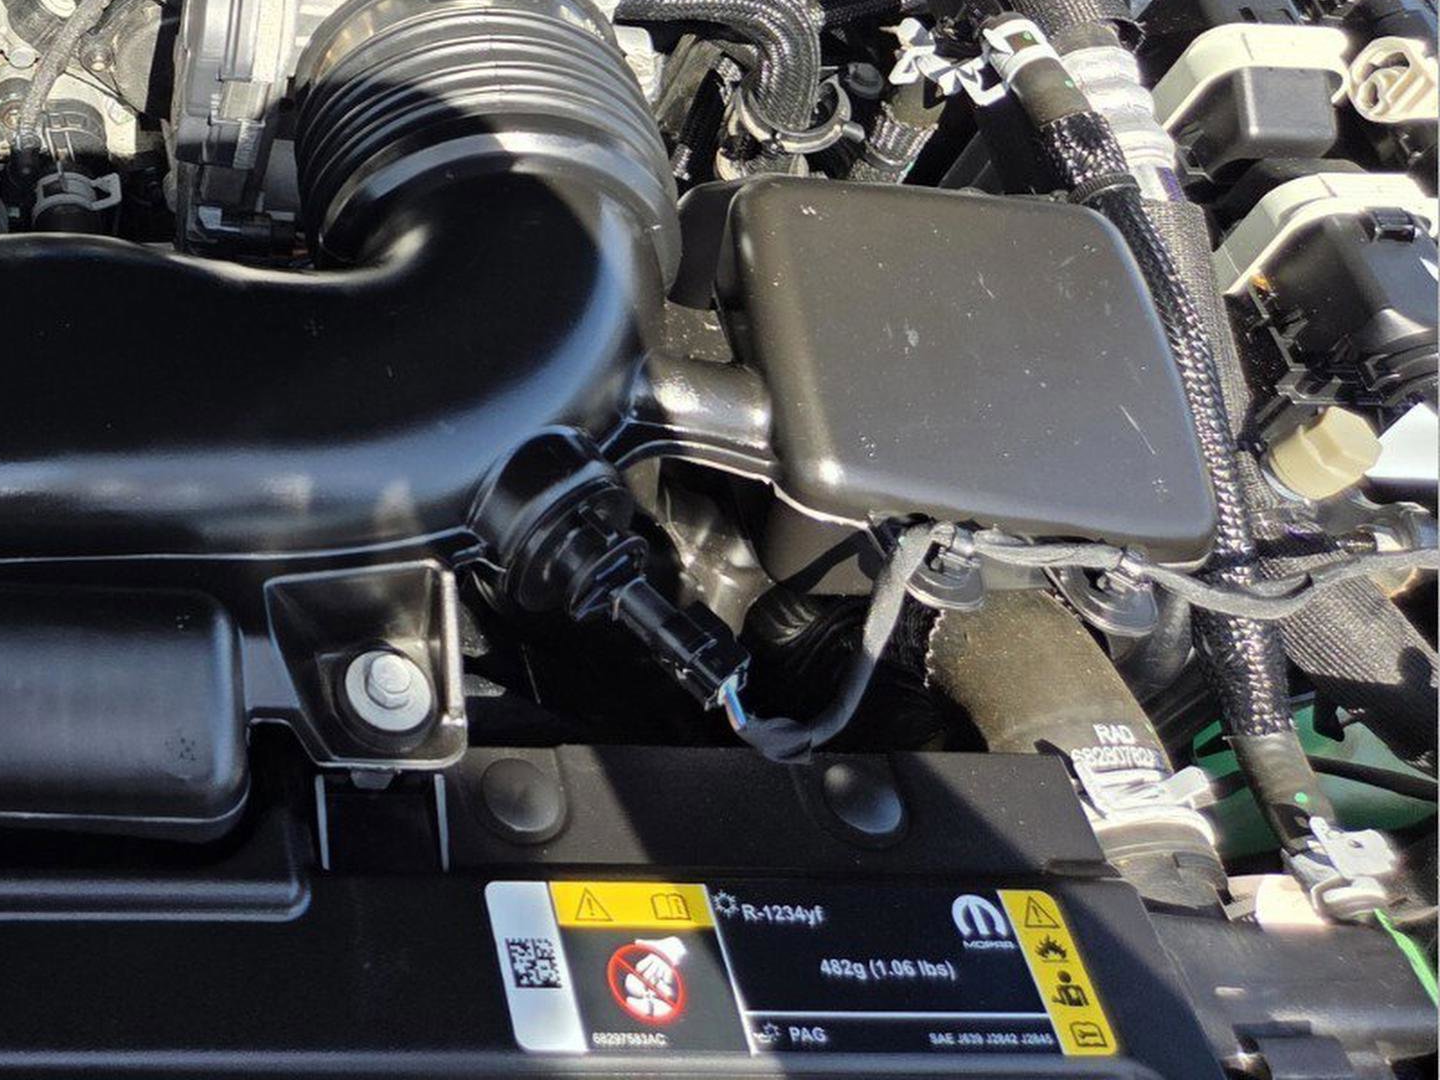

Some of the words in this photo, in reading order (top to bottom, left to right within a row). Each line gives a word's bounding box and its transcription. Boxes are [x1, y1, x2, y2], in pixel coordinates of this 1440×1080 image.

[1092, 723, 1137, 745] RAD
[741, 904, 824, 926] R-1234yf
[819, 958, 866, 979] 482g
[869, 959, 915, 980] (1.06
[920, 959, 956, 981] lbs)
[788, 1027, 827, 1043] PAG
[928, 1031, 955, 1045] SAE
